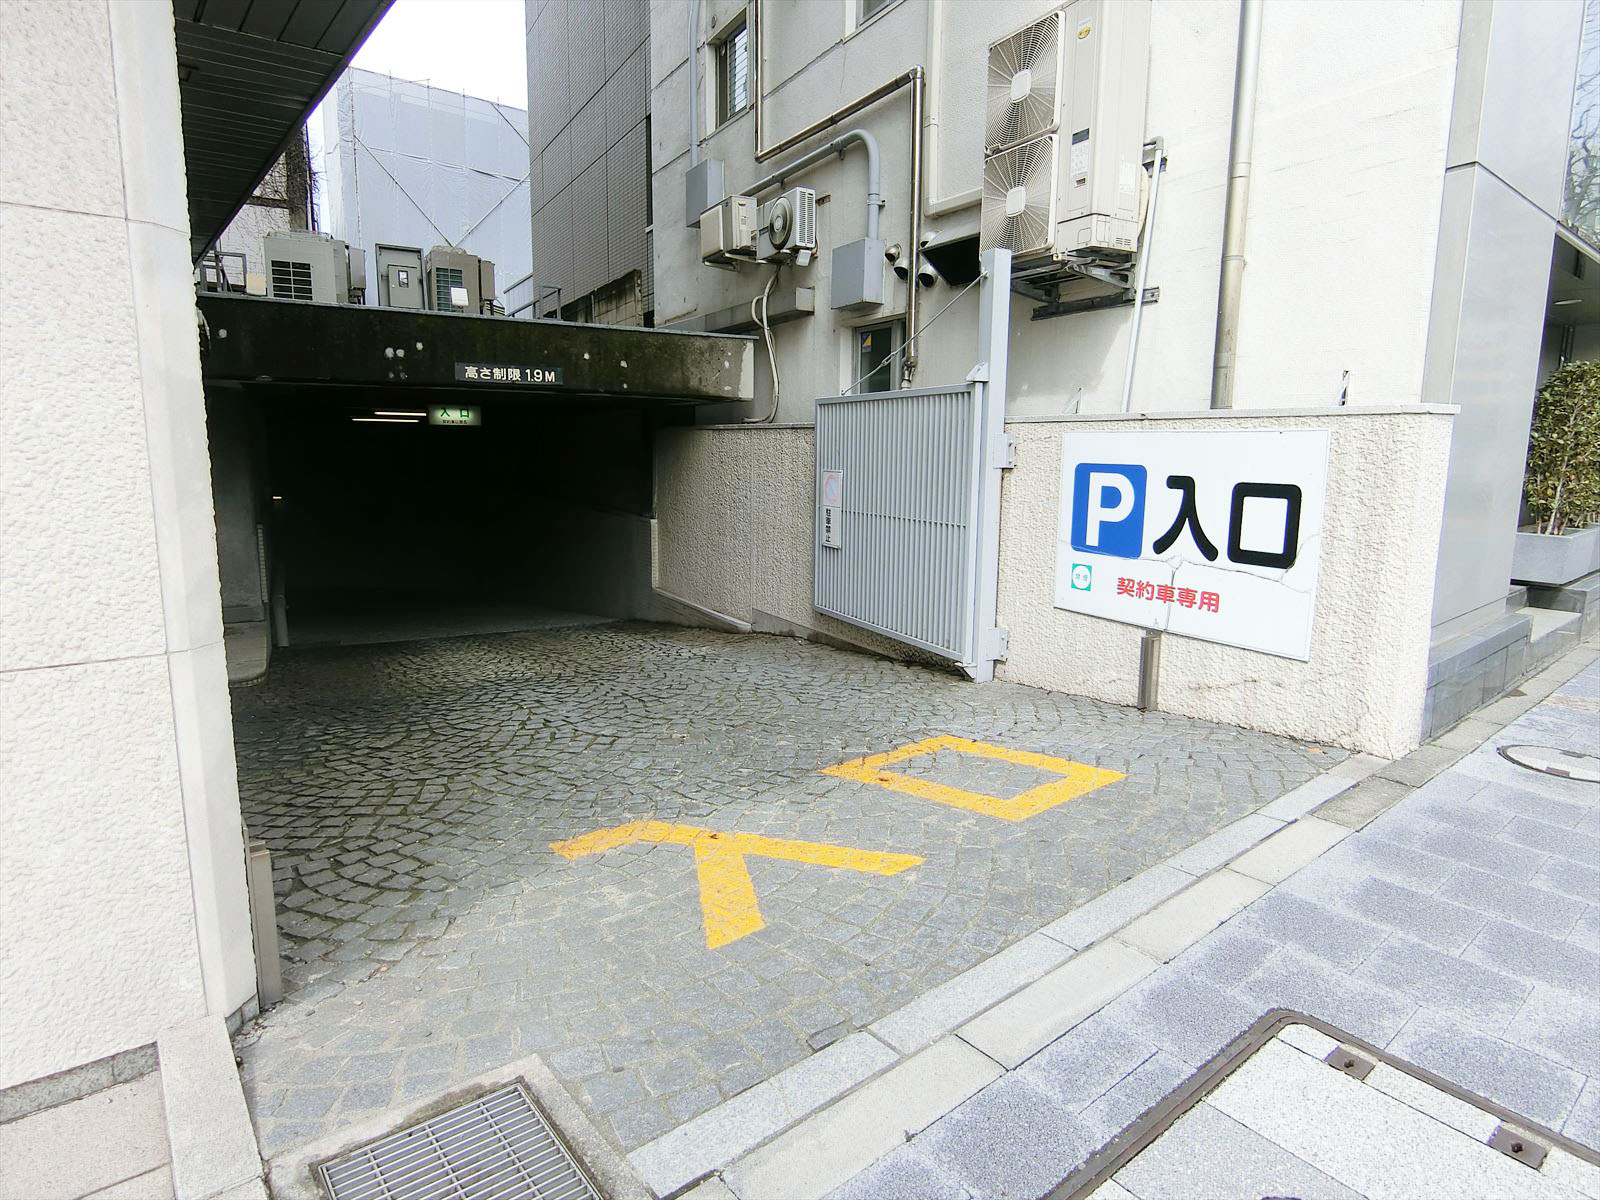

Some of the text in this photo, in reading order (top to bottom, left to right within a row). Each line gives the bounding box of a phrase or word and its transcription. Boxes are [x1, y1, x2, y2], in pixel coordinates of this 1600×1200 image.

[464, 366, 521, 381] 高さ制限
[440, 408, 470, 418] 入口
[1086, 472, 1302, 569] P 入口
[1116, 576, 1220, 613] 契約車専用
